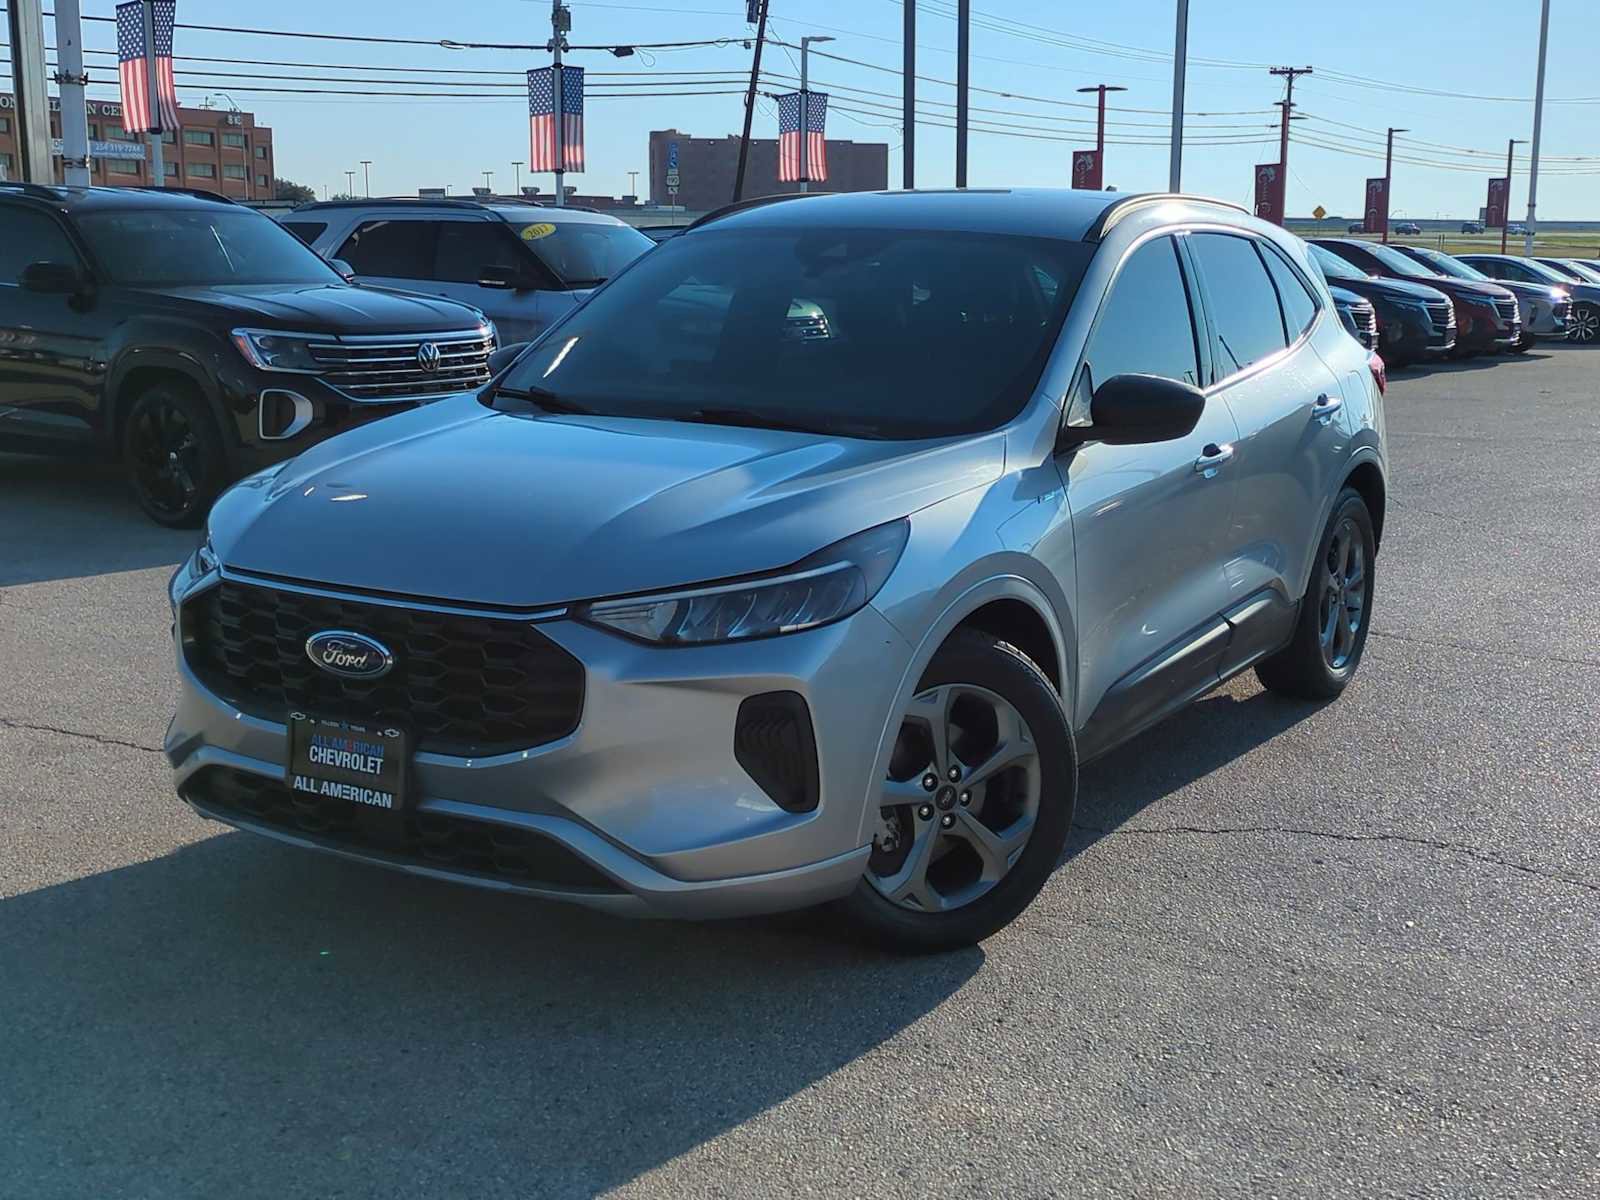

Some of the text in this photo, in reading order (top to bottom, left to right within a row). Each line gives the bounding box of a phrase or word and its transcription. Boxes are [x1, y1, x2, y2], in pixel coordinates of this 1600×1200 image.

[322, 639, 369, 669] Ford
[310, 745, 384, 775] CHEVROLET
[312, 735, 384, 757] ALL AMERICAN
[293, 775, 393, 809] ALL AMERICAN
